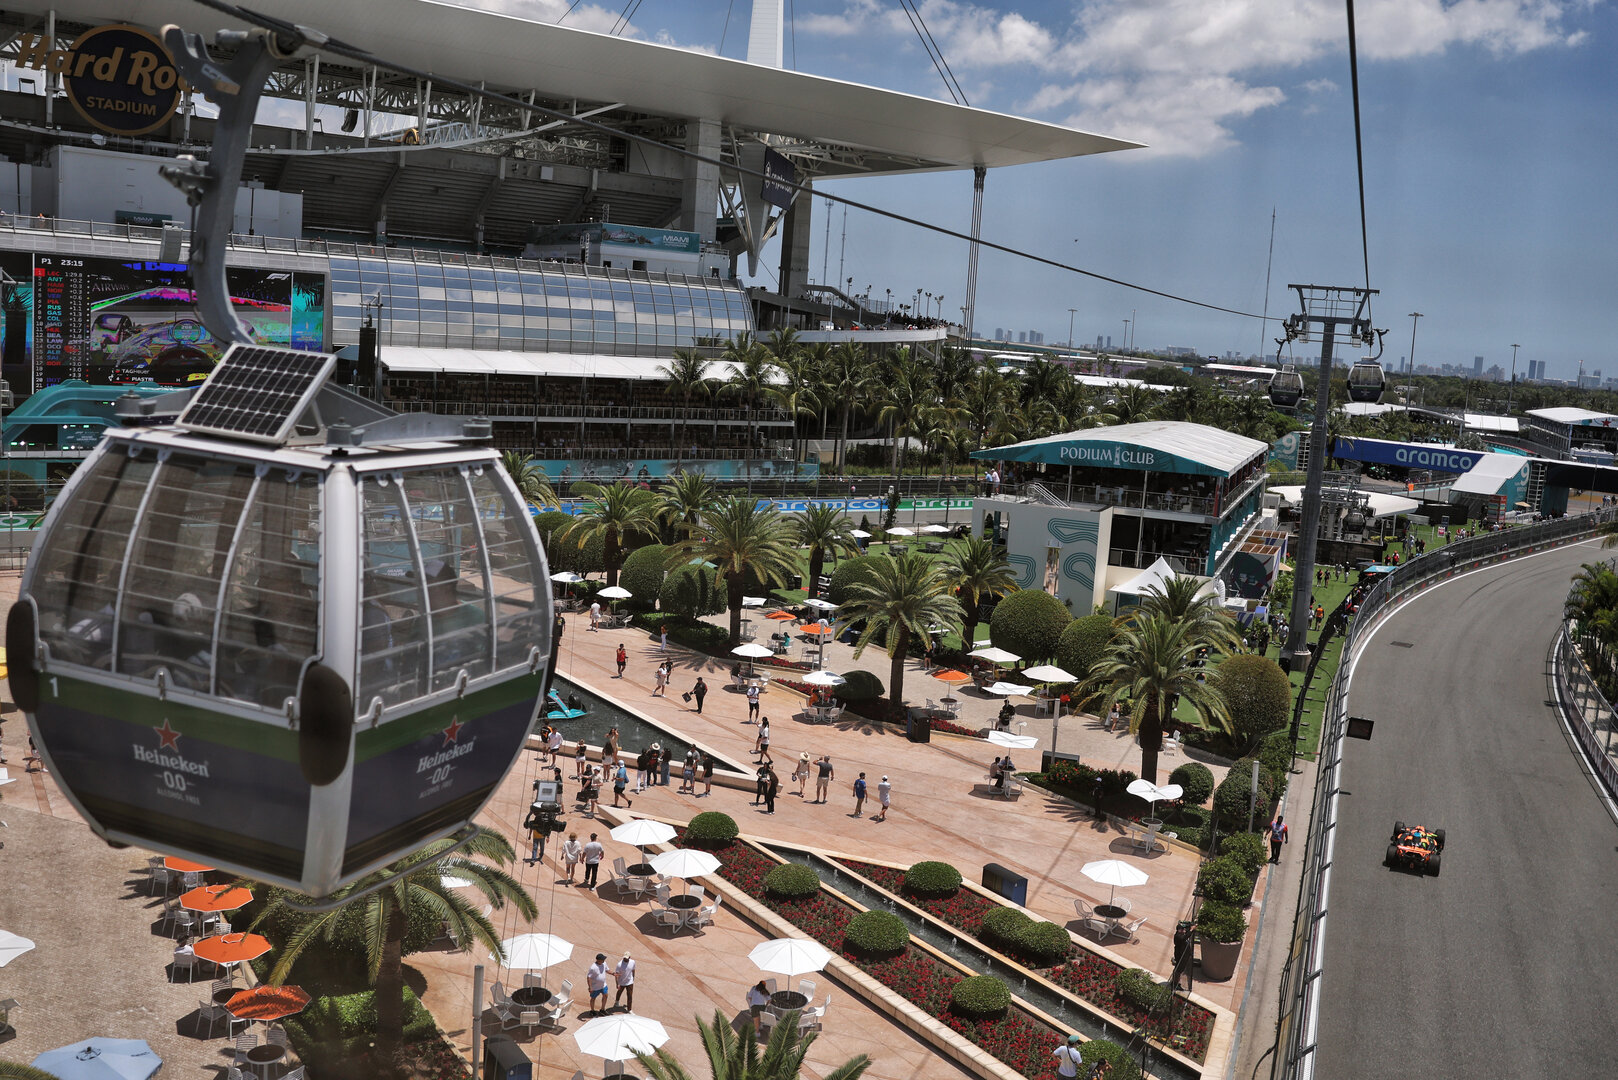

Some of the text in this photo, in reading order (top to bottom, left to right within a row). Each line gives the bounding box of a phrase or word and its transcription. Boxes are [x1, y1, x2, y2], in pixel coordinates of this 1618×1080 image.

[15, 32, 124, 82] Hard
[86, 95, 157, 117] STADIUM
[662, 234, 690, 243] MIAMI
[41, 257, 84, 267] P1 23:15
[1060, 446, 1155, 465] PODIUM CLUB
[1282, 434, 1297, 455] 9
[1396, 448, 1473, 470] aramco
[1520, 463, 1530, 486] 9
[49, 676, 59, 698] 1
[133, 744, 210, 778] Heineken
[416, 741, 474, 774] Heineken
